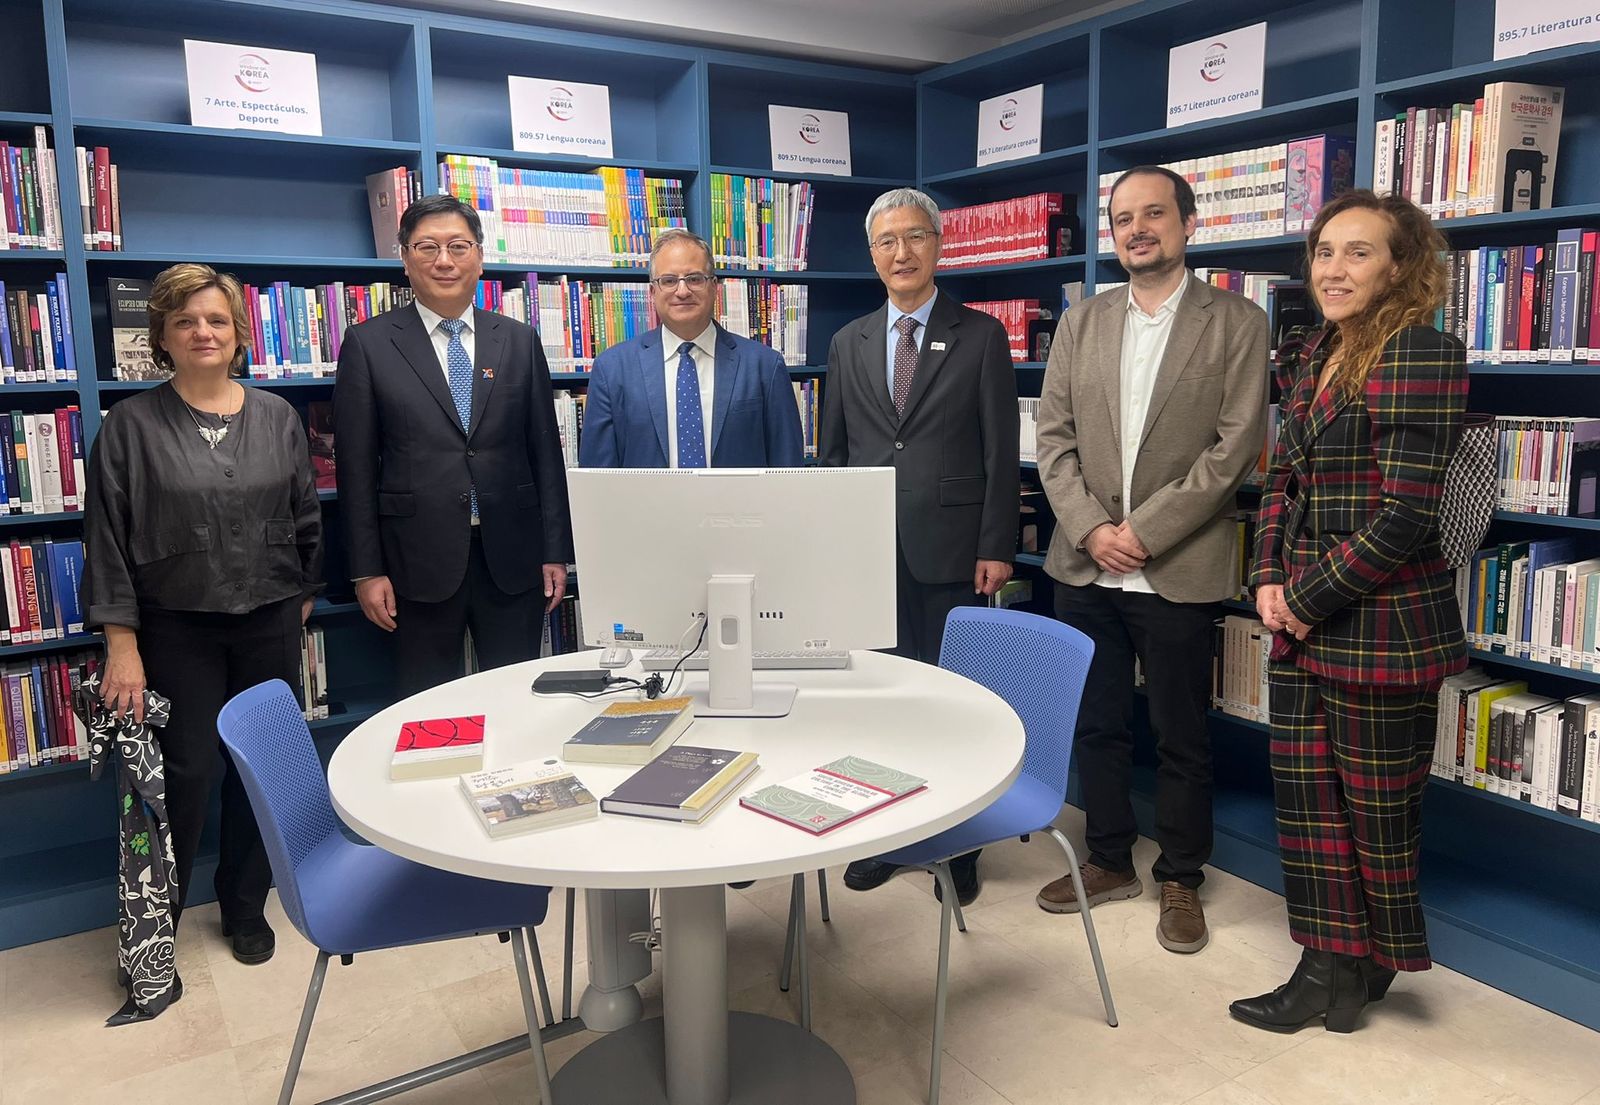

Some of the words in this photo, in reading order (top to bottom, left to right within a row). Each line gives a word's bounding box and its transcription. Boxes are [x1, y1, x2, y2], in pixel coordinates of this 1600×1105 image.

[1498, 28, 1528, 42] 895.7
[1530, 15, 1592, 36] Literatura
[1204, 58, 1226, 68] KOREA
[239, 69, 270, 80] KOREA
[205, 97, 212, 106] 7
[214, 98, 240, 108] Arte.
[550, 101, 573, 109] KOREA
[1169, 104, 1188, 115] 895.7
[1189, 96, 1226, 111] Literatura
[1228, 88, 1260, 102] coreana
[238, 114, 280, 125] Deporte
[520, 131, 544, 140] 809.57
[546, 134, 574, 144] Lengua
[576, 137, 606, 146] coreana
[992, 143, 1017, 154] Literatura
[1018, 138, 1038, 148] coreana
[777, 154, 798, 162] 809.57
[798, 156, 822, 164] Lengua
[16, 720, 26, 751] KOREA
